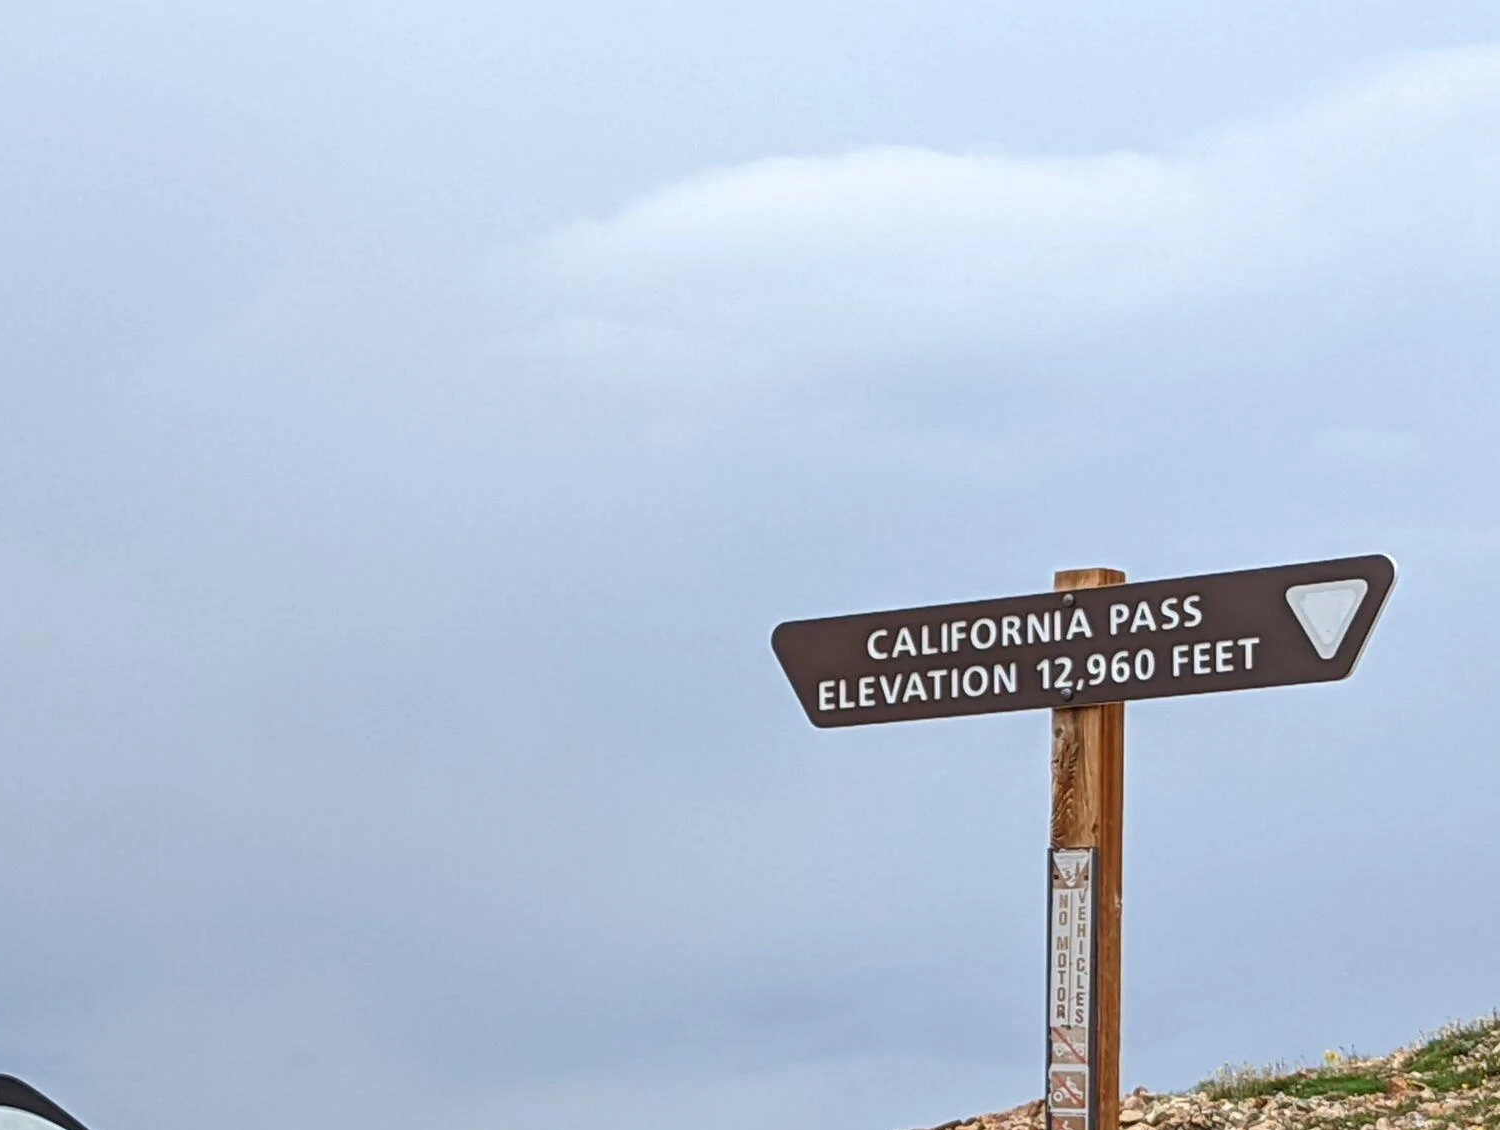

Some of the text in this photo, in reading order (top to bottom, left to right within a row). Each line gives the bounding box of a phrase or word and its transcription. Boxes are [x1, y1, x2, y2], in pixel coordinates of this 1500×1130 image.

[817, 636, 1261, 712] ELEVATION 12,960 FEET
[866, 593, 1203, 660] CALIFORNIA PASS
[1056, 893, 1069, 1020] NO MOTOR
[1075, 888, 1088, 1025] VEHICLES
